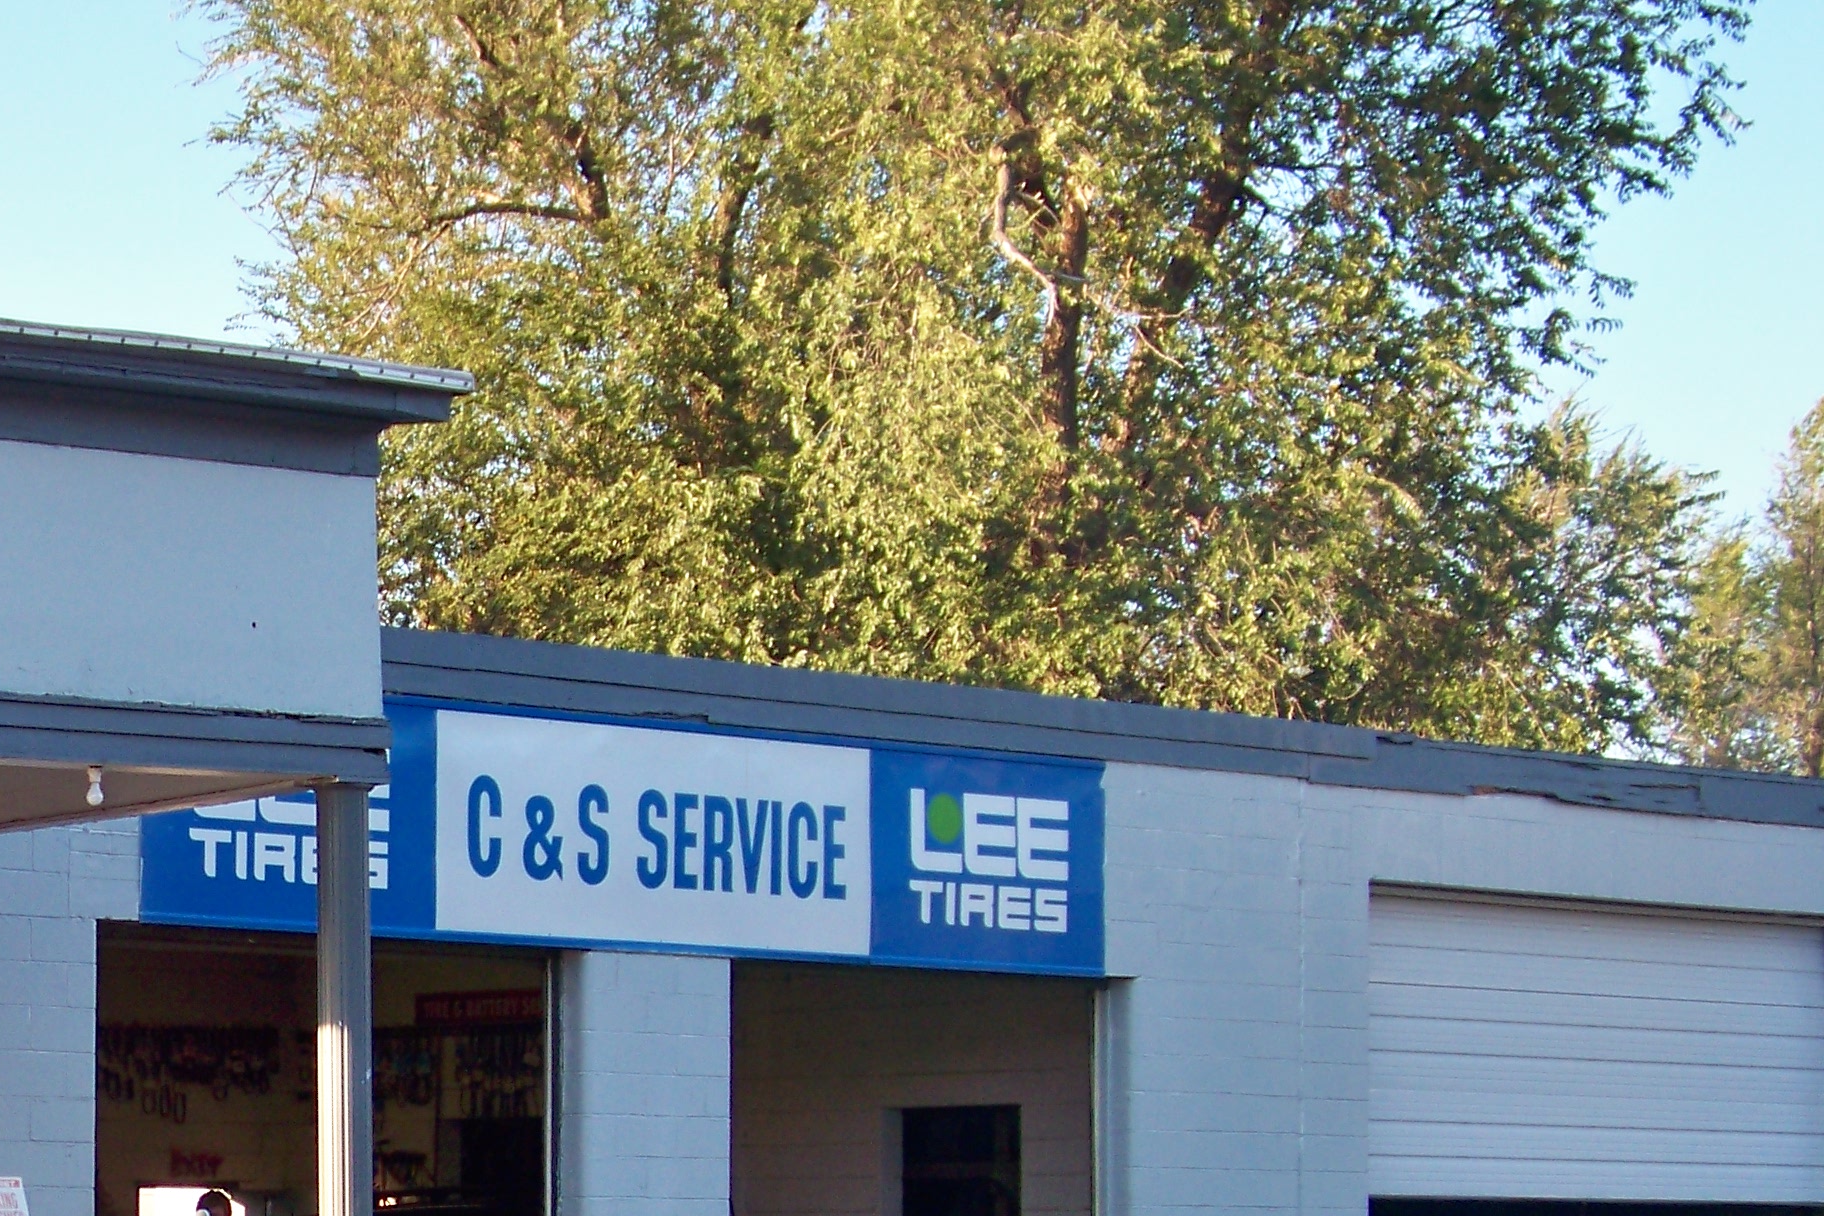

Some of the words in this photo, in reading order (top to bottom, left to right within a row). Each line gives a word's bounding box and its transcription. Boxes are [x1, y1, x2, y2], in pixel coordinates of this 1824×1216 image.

[467, 774, 503, 878] C
[522, 794, 563, 882] &
[577, 783, 610, 886] S
[636, 788, 847, 901] SERVICE
[910, 788, 1069, 881] LEE
[909, 879, 1068, 933] TIRES
